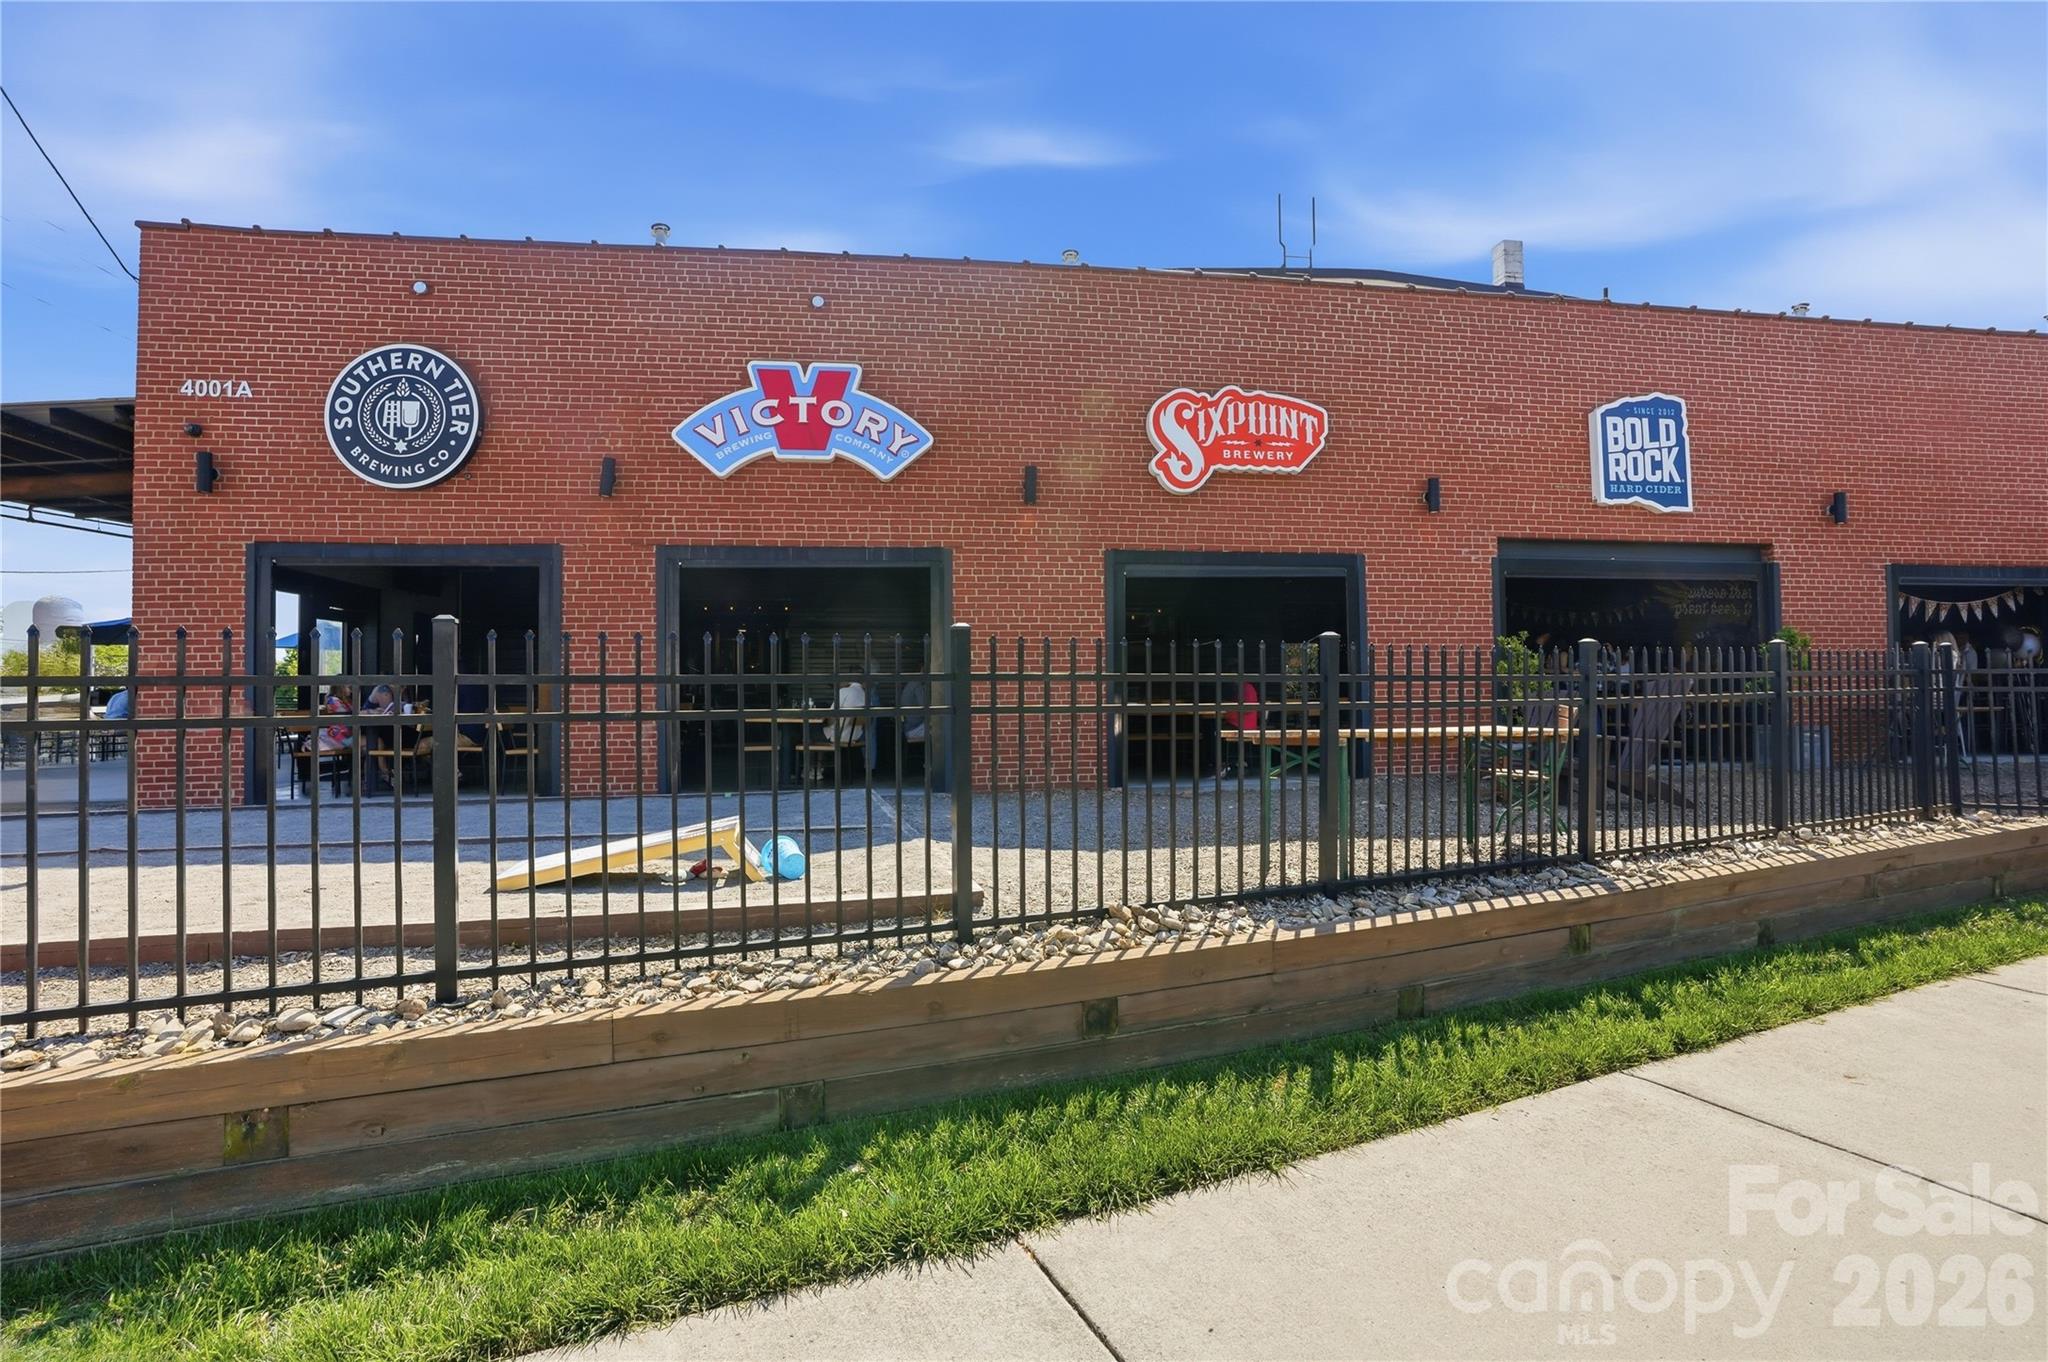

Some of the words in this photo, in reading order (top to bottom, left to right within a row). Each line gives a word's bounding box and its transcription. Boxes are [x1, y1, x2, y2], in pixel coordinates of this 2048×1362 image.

[180, 379, 253, 398] 4001A
[334, 352, 445, 430] SOUTHERN
[444, 378, 471, 436] TIER
[693, 396, 919, 456] VICTORY
[1633, 407, 1655, 416] SINCE
[1658, 408, 1676, 416] 2012
[715, 431, 773, 460] BREWING
[835, 433, 894, 464] COMPANY
[1606, 416, 1677, 452] BOLD
[350, 446, 425, 477] BREWING
[428, 449, 449, 467] CO
[1223, 450, 1294, 461] BREWERY
[1608, 446, 1682, 483] ROCK
[1610, 484, 1643, 493] HARD
[1645, 485, 1682, 494] CIDER
